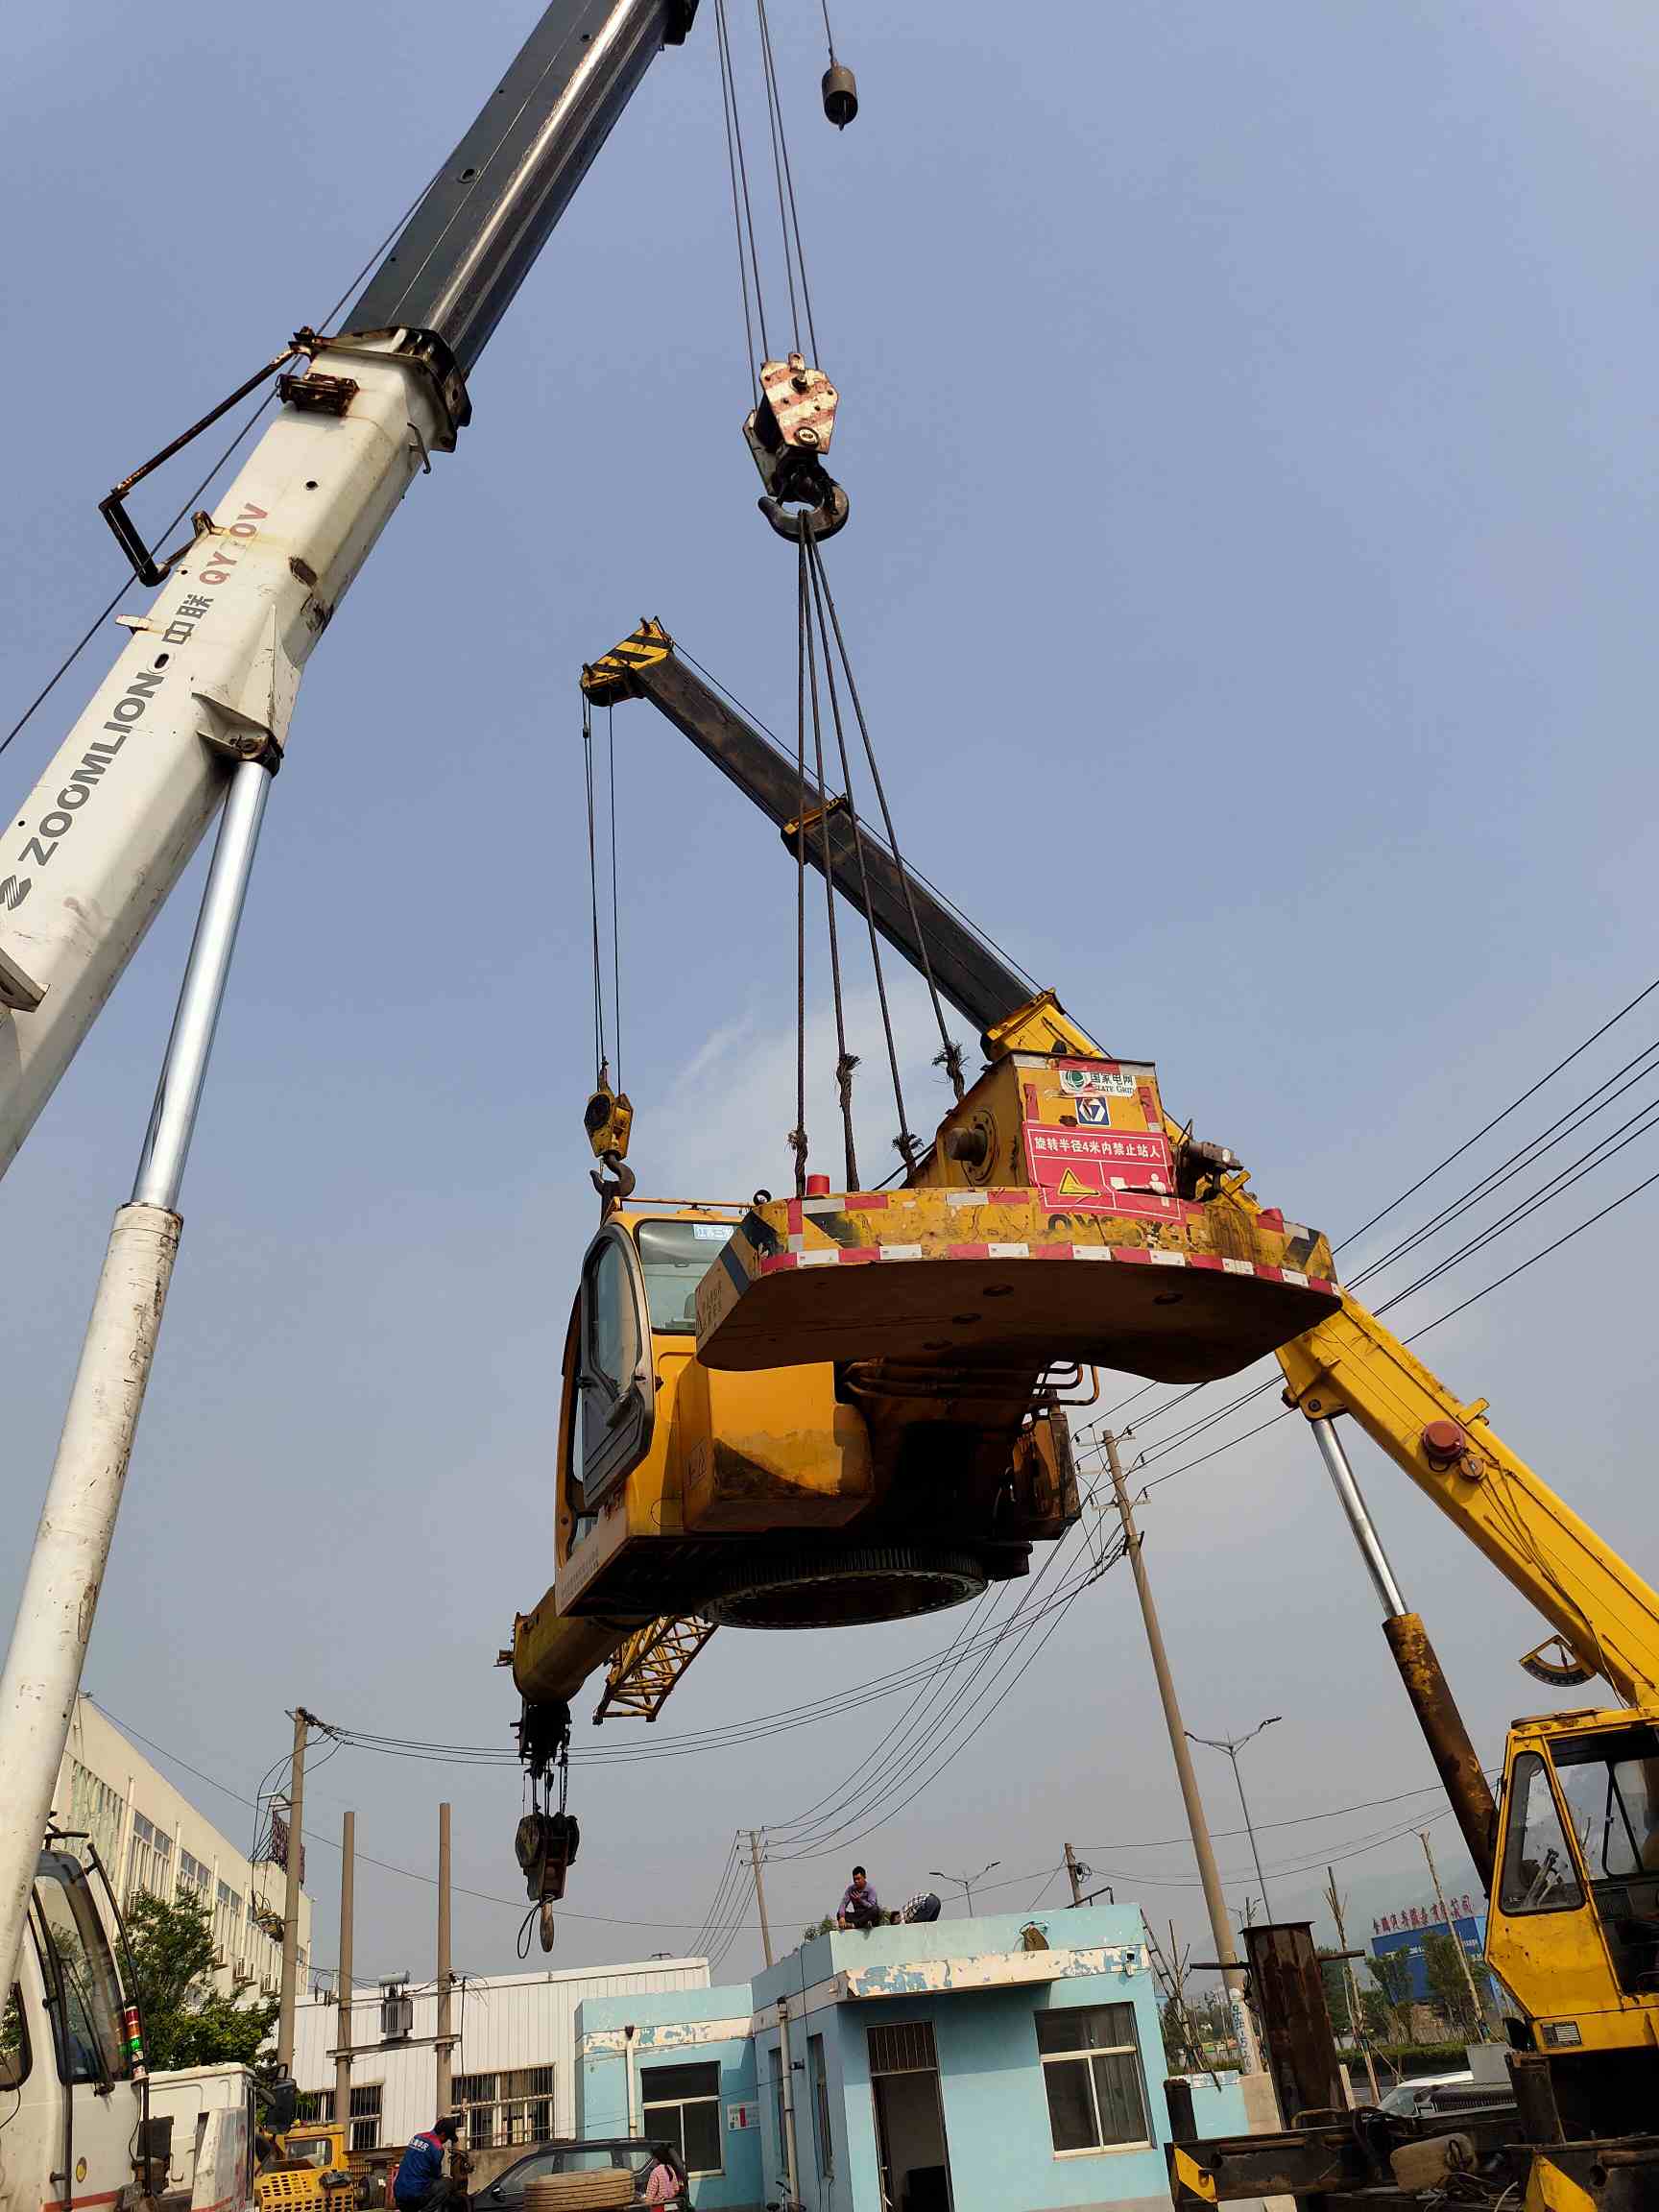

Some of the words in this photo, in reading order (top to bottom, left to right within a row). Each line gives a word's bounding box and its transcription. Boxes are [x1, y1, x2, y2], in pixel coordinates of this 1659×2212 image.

[17, 671, 165, 866] ZOOMLION
[161, 593, 214, 645] 中联
[1090, 1072, 1133, 1087] 国家电网
[1035, 1136, 1161, 1158] 旋转半径4米内禁止站人
